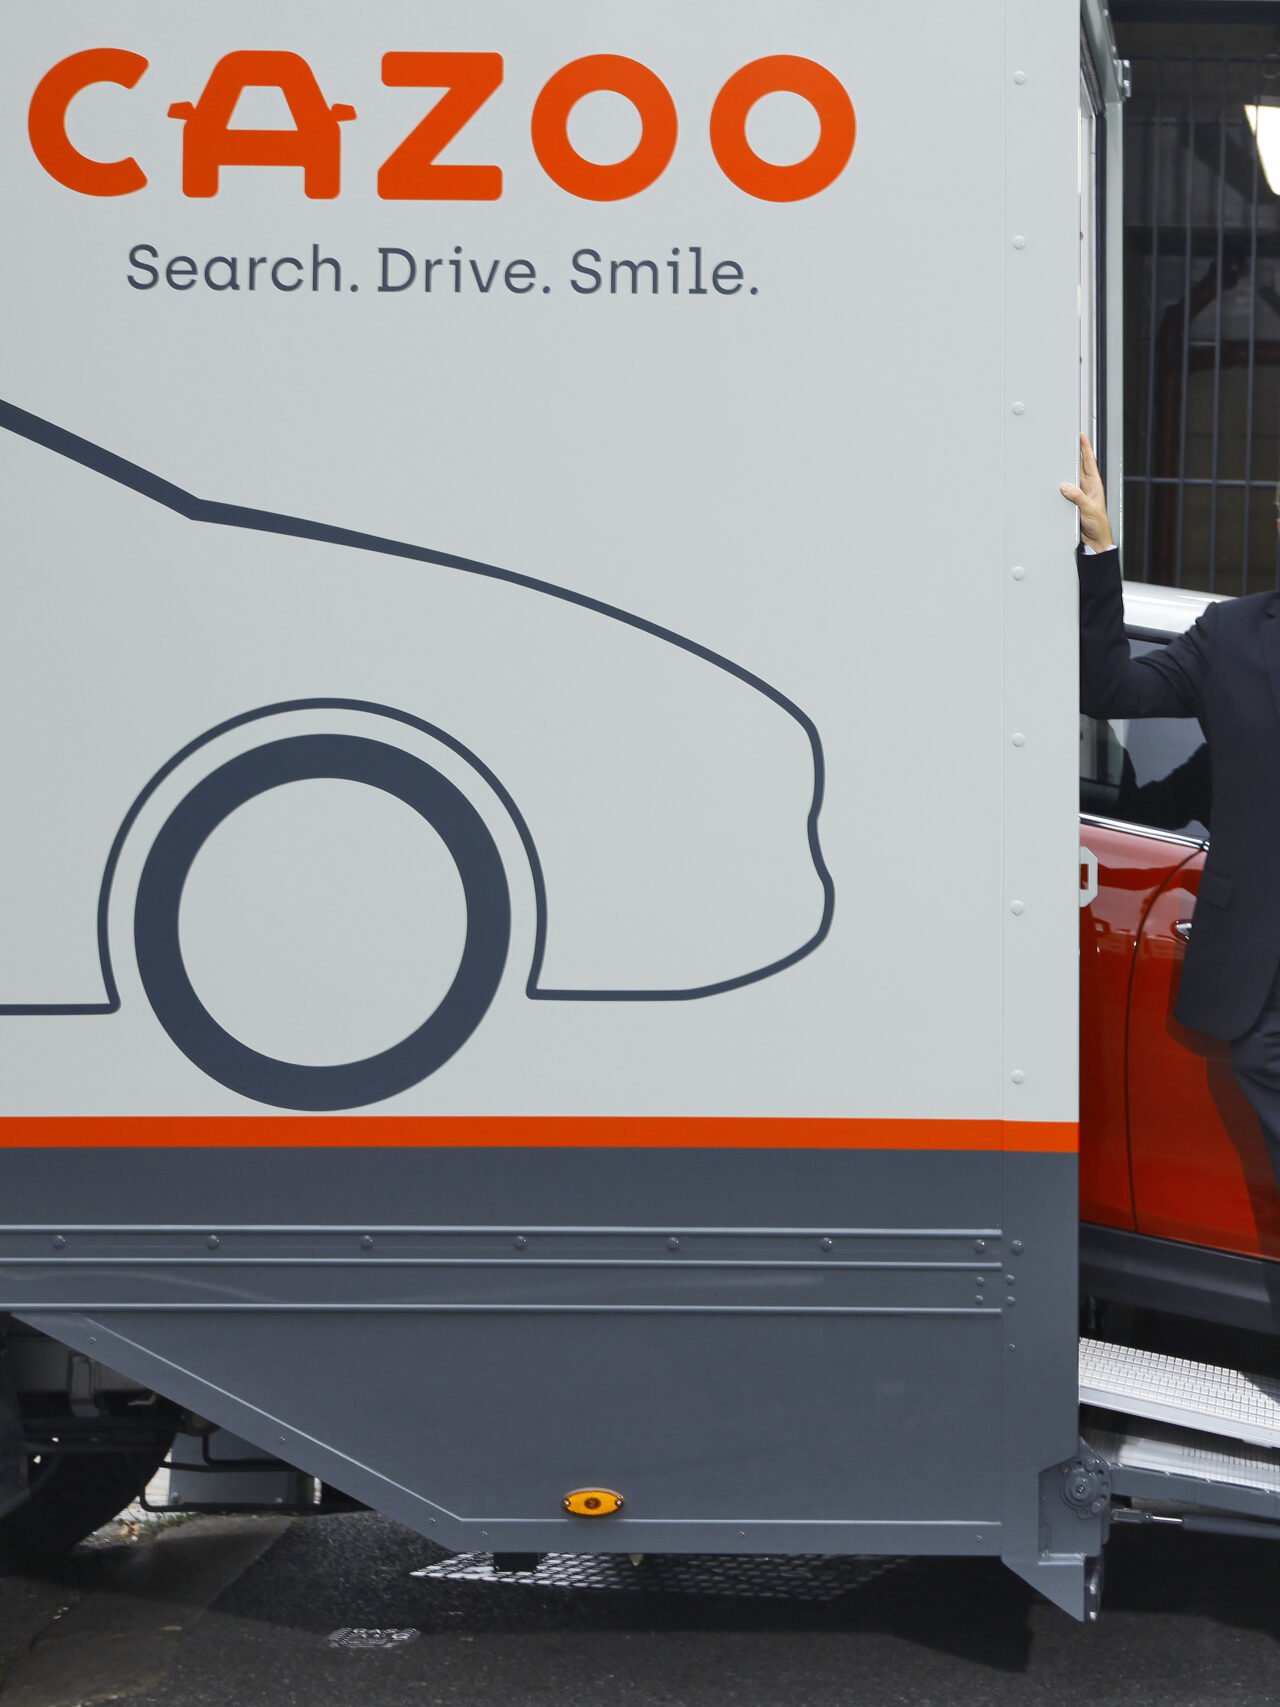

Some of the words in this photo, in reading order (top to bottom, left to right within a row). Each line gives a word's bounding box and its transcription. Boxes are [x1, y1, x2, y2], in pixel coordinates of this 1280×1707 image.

[27, 47, 857, 204] CAZOO
[126, 243, 360, 293] Search.
[376, 245, 552, 295] Drive.
[570, 246, 760, 296] Smile.
